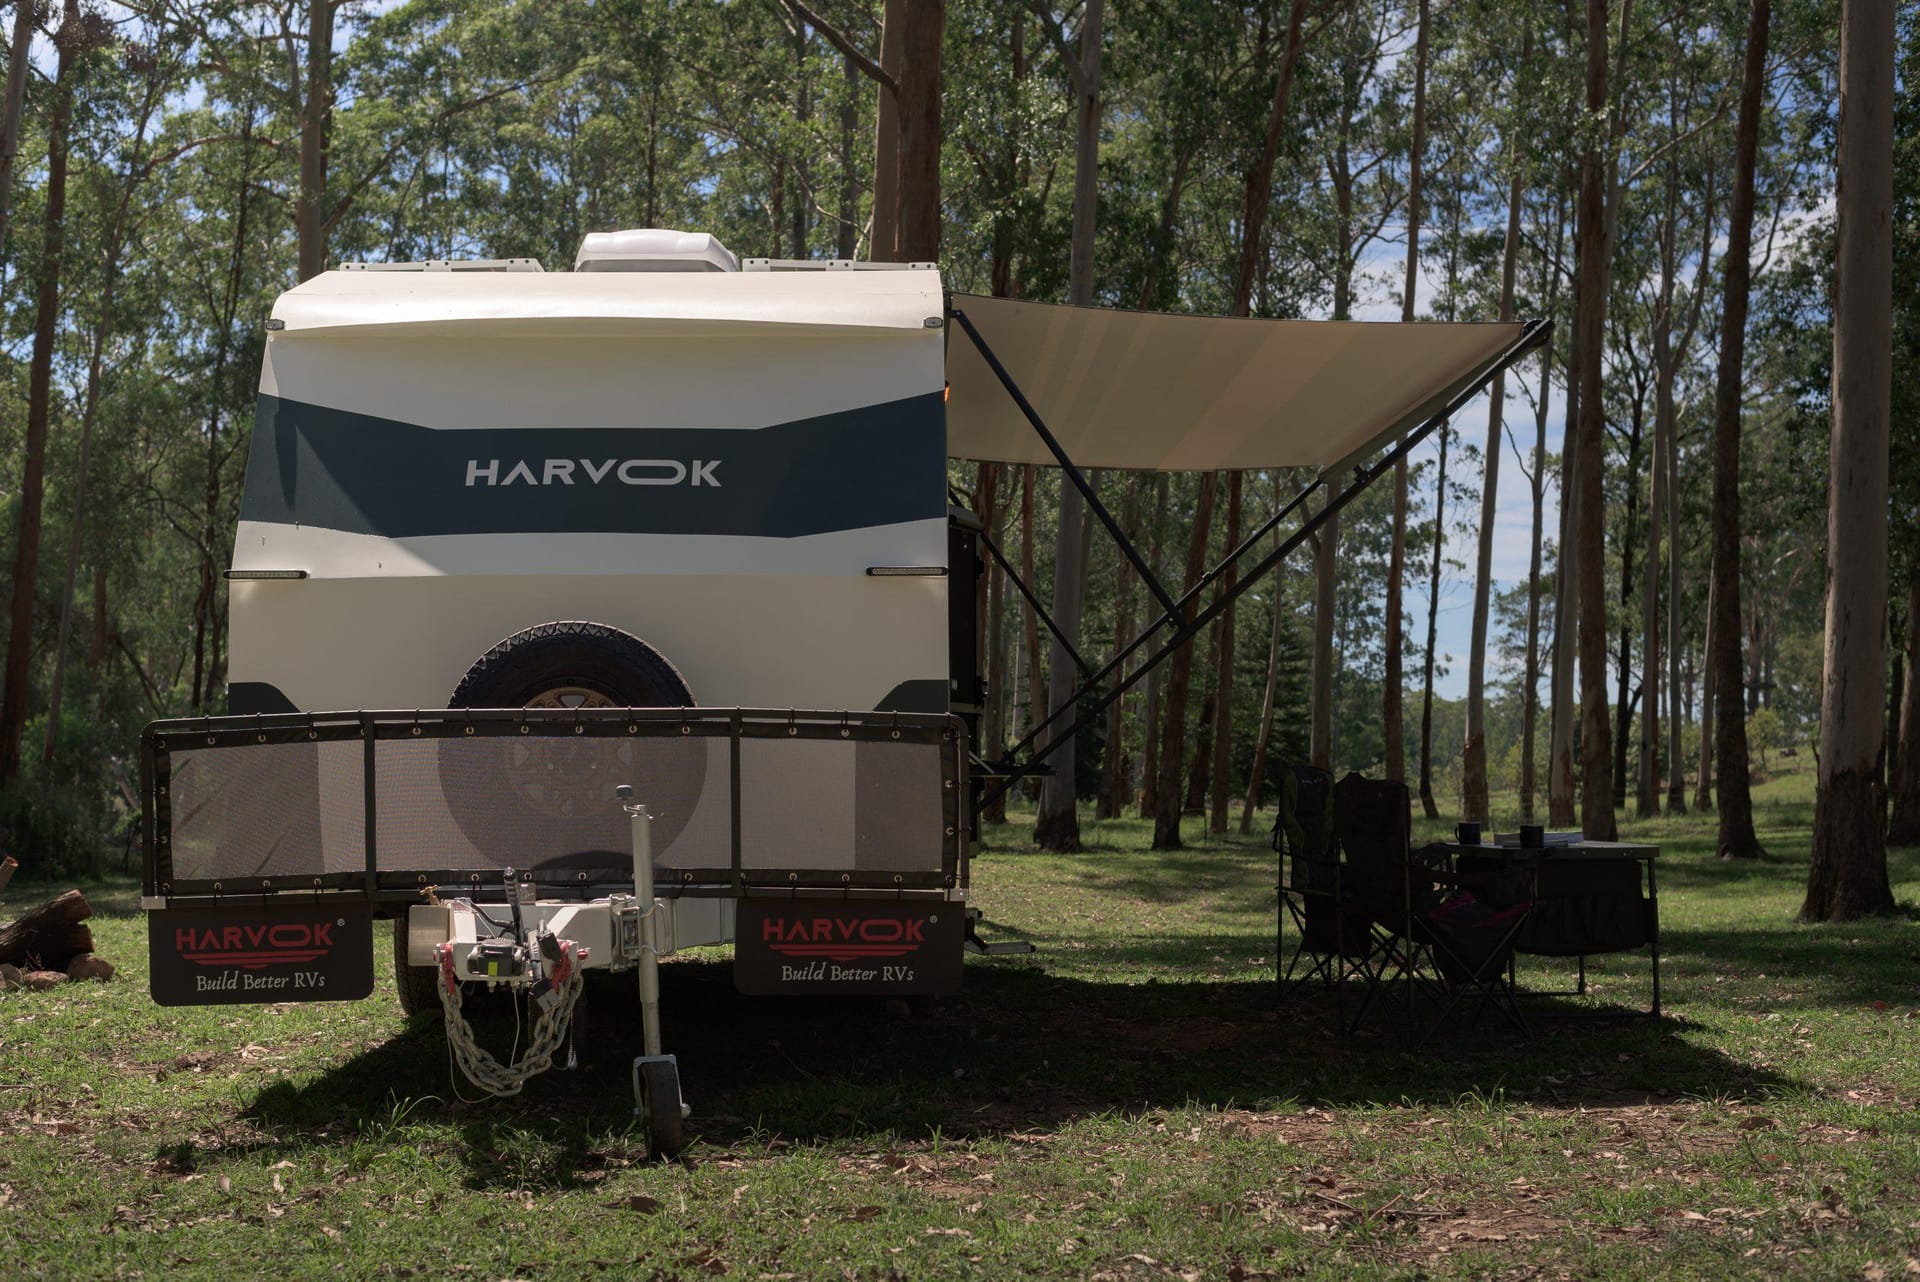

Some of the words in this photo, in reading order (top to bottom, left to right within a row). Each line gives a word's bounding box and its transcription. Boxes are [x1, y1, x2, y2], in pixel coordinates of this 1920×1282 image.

[465, 459, 722, 487] HARVOK
[196, 970, 239, 991] Build
[243, 974, 289, 990] Better
[294, 971, 326, 988] RVs
[781, 961, 827, 982] Build
[830, 965, 877, 981] Better
[882, 965, 915, 981] RVs
